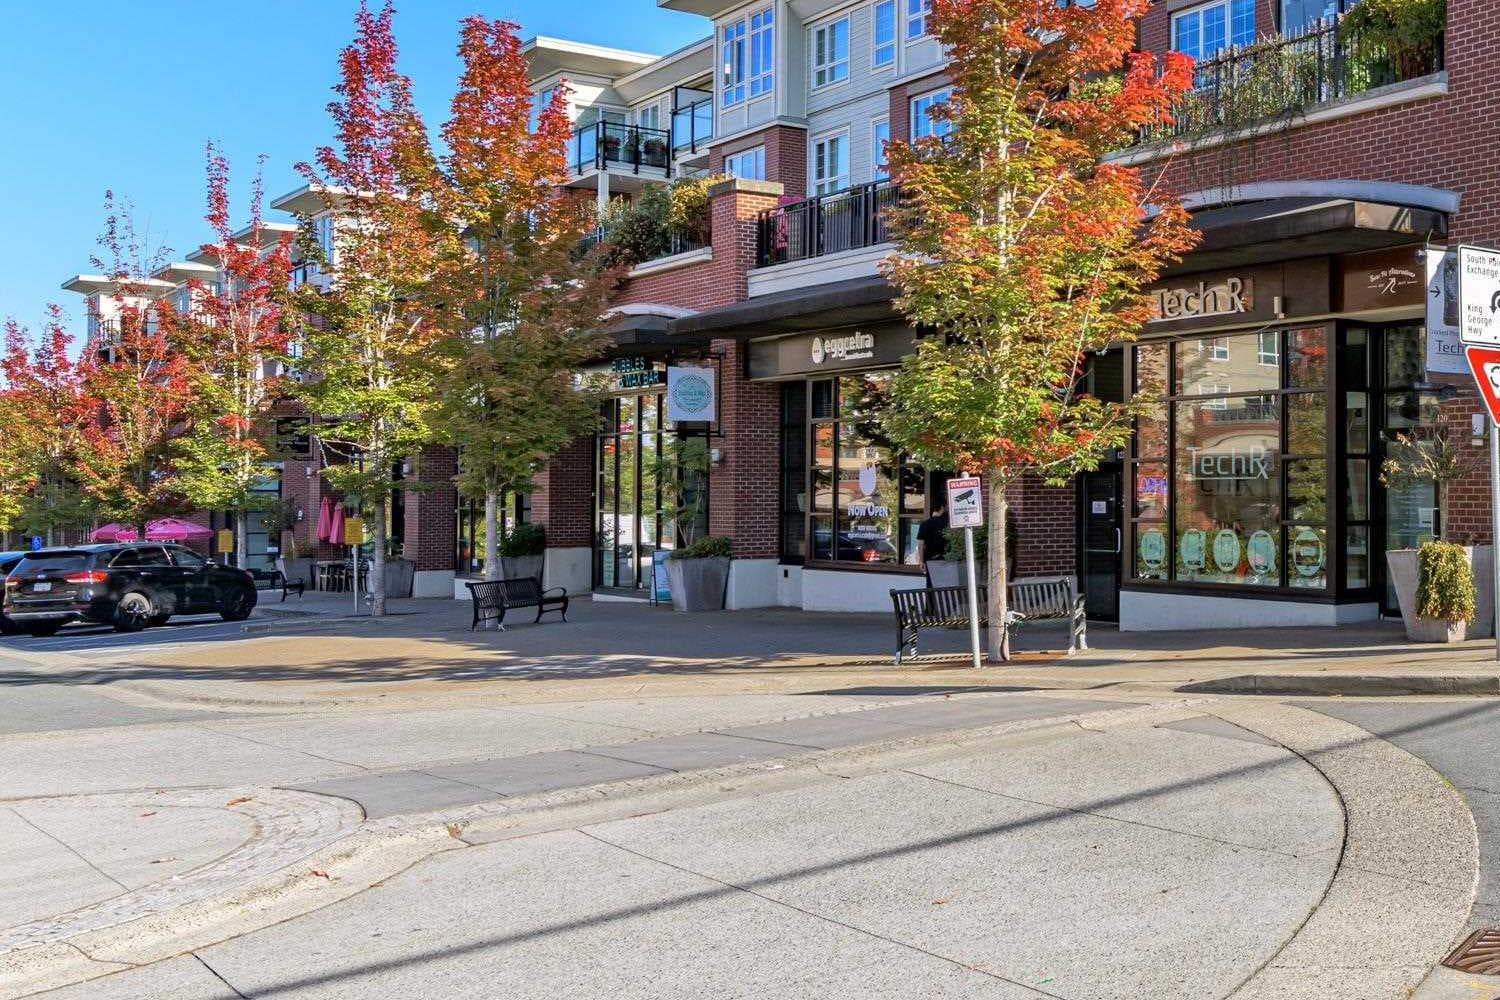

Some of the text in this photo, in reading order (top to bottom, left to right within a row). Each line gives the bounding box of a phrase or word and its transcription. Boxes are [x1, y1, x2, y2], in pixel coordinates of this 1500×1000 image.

[1466, 254, 1486, 265] South
[1466, 265, 1499, 277] Exchange
[1467, 304, 1483, 315] King
[1467, 315, 1492, 326] George
[1467, 327, 1483, 336] Hwy
[643, 370, 659, 384] BAR
[1437, 414, 1448, 423] 120
[868, 502, 888, 516] OPEN
